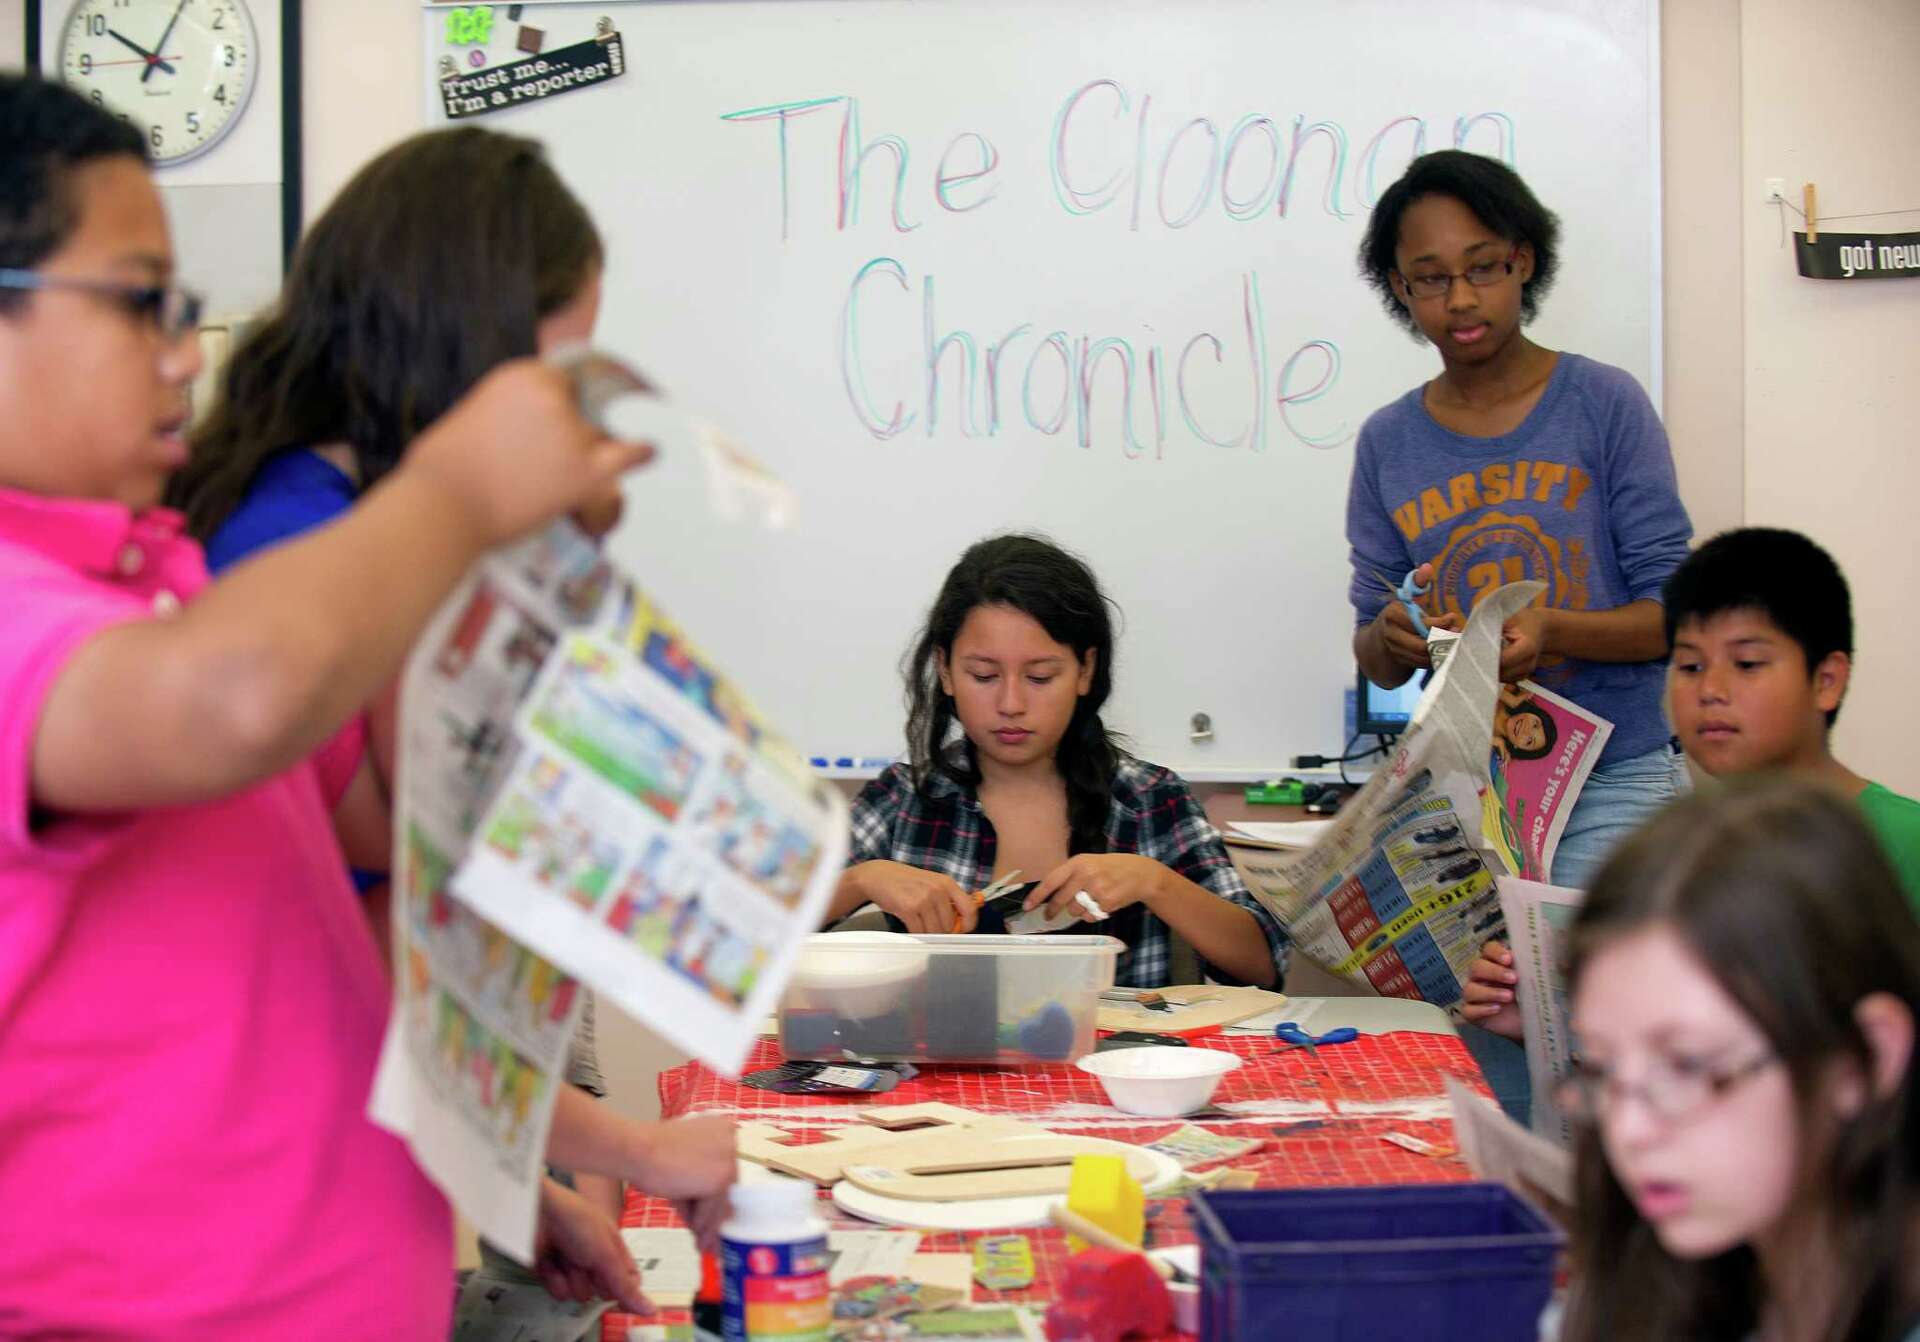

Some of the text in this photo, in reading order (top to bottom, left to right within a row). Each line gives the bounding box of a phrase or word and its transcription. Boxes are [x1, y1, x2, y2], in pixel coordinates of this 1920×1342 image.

[86, 14, 106, 36] 10
[212, 8, 225, 30] 2
[79, 53, 92, 75] 9
[223, 45, 236, 67] 3
[212, 84, 226, 106] 4
[442, 70, 510, 98] Trust
[446, 62, 610, 115] I'm a reporter
[151, 125, 164, 147] 6
[186, 112, 199, 134] 5
[720, 95, 1001, 242] The
[1840, 240, 1874, 277] got
[838, 257, 1355, 460] Chronicle
[1393, 460, 1592, 543] VARSITY
[1554, 728, 1587, 777] Here's
[1539, 777, 1561, 815] your
